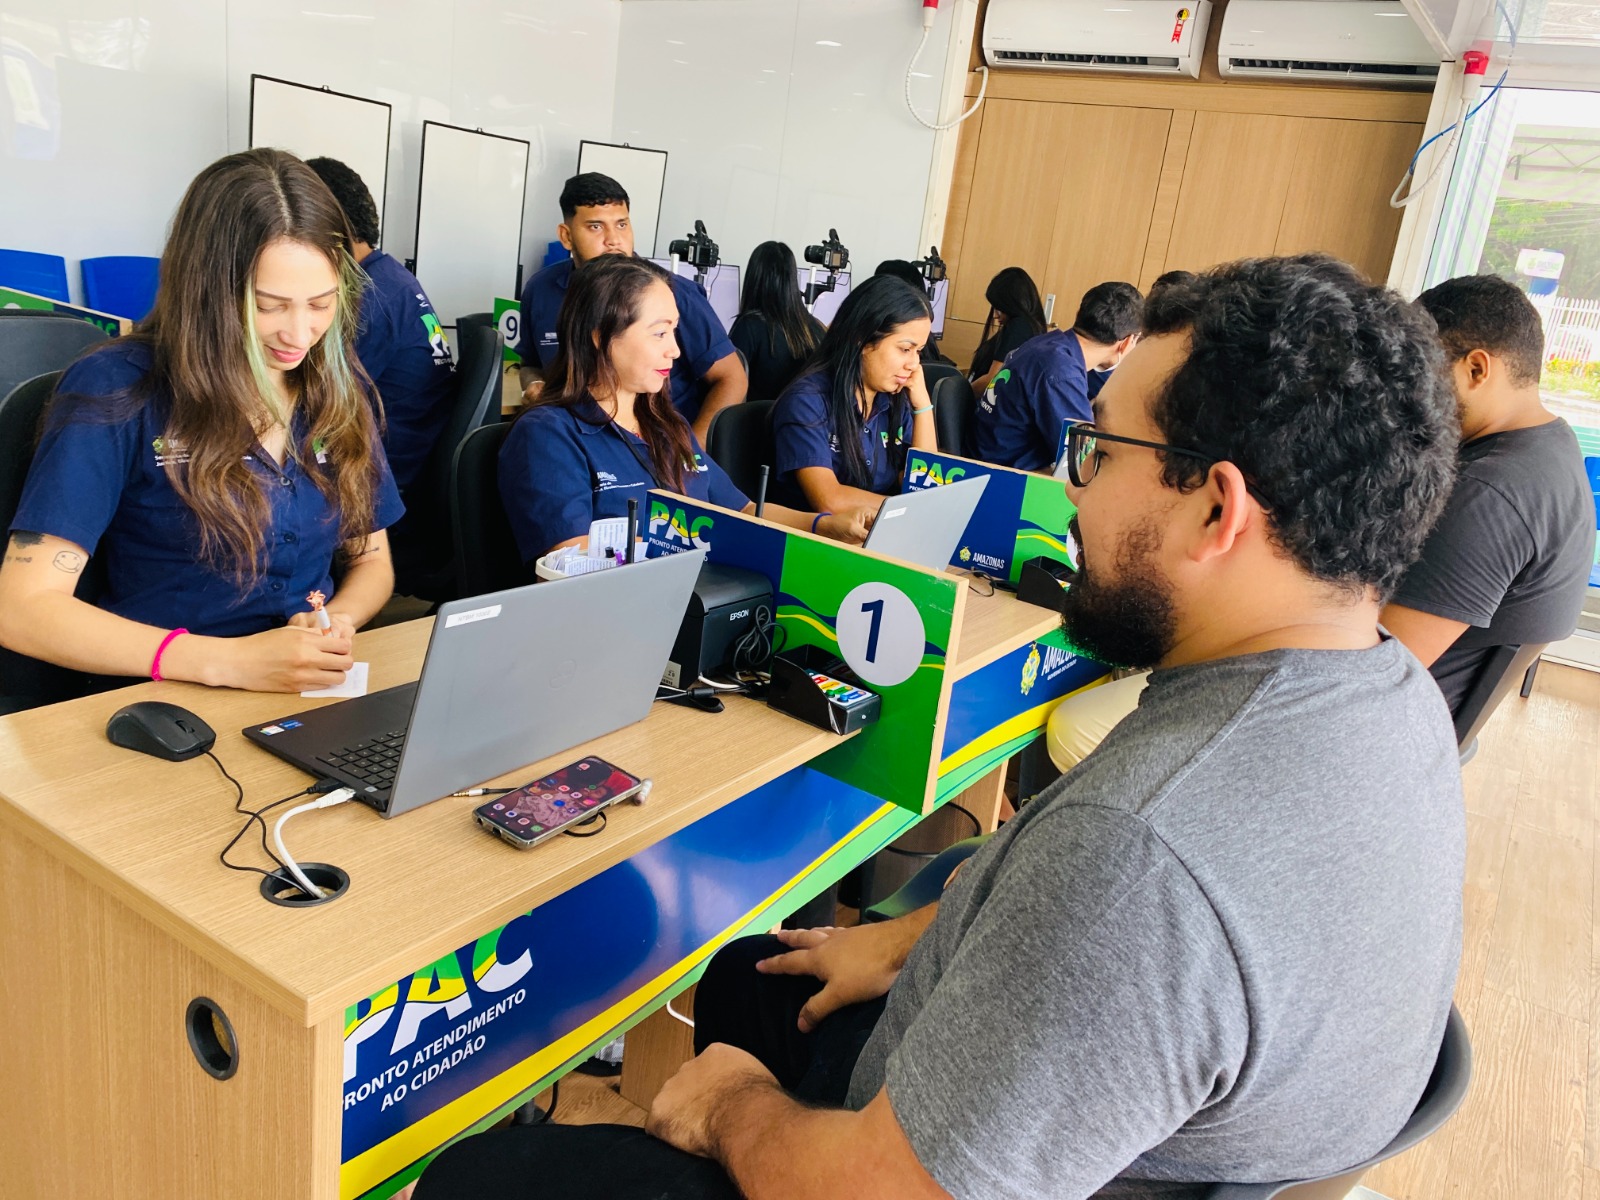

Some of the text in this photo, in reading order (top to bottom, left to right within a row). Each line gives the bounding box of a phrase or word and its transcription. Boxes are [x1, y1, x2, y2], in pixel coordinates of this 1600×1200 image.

[506, 316, 518, 340] 9
[909, 458, 966, 487] PAC
[649, 500, 714, 552] PAC
[649, 537, 671, 549] PRONTO
[973, 552, 1005, 569] AMAZONAS
[730, 609, 749, 621] EPSON
[861, 599, 884, 664] 1
[1041, 646, 1077, 676] AMAZ
[344, 910, 533, 1084] PAC
[342, 988, 526, 1111] RONTO ATENDIMENTO
[381, 1035, 486, 1112] AO CIDADÃO
